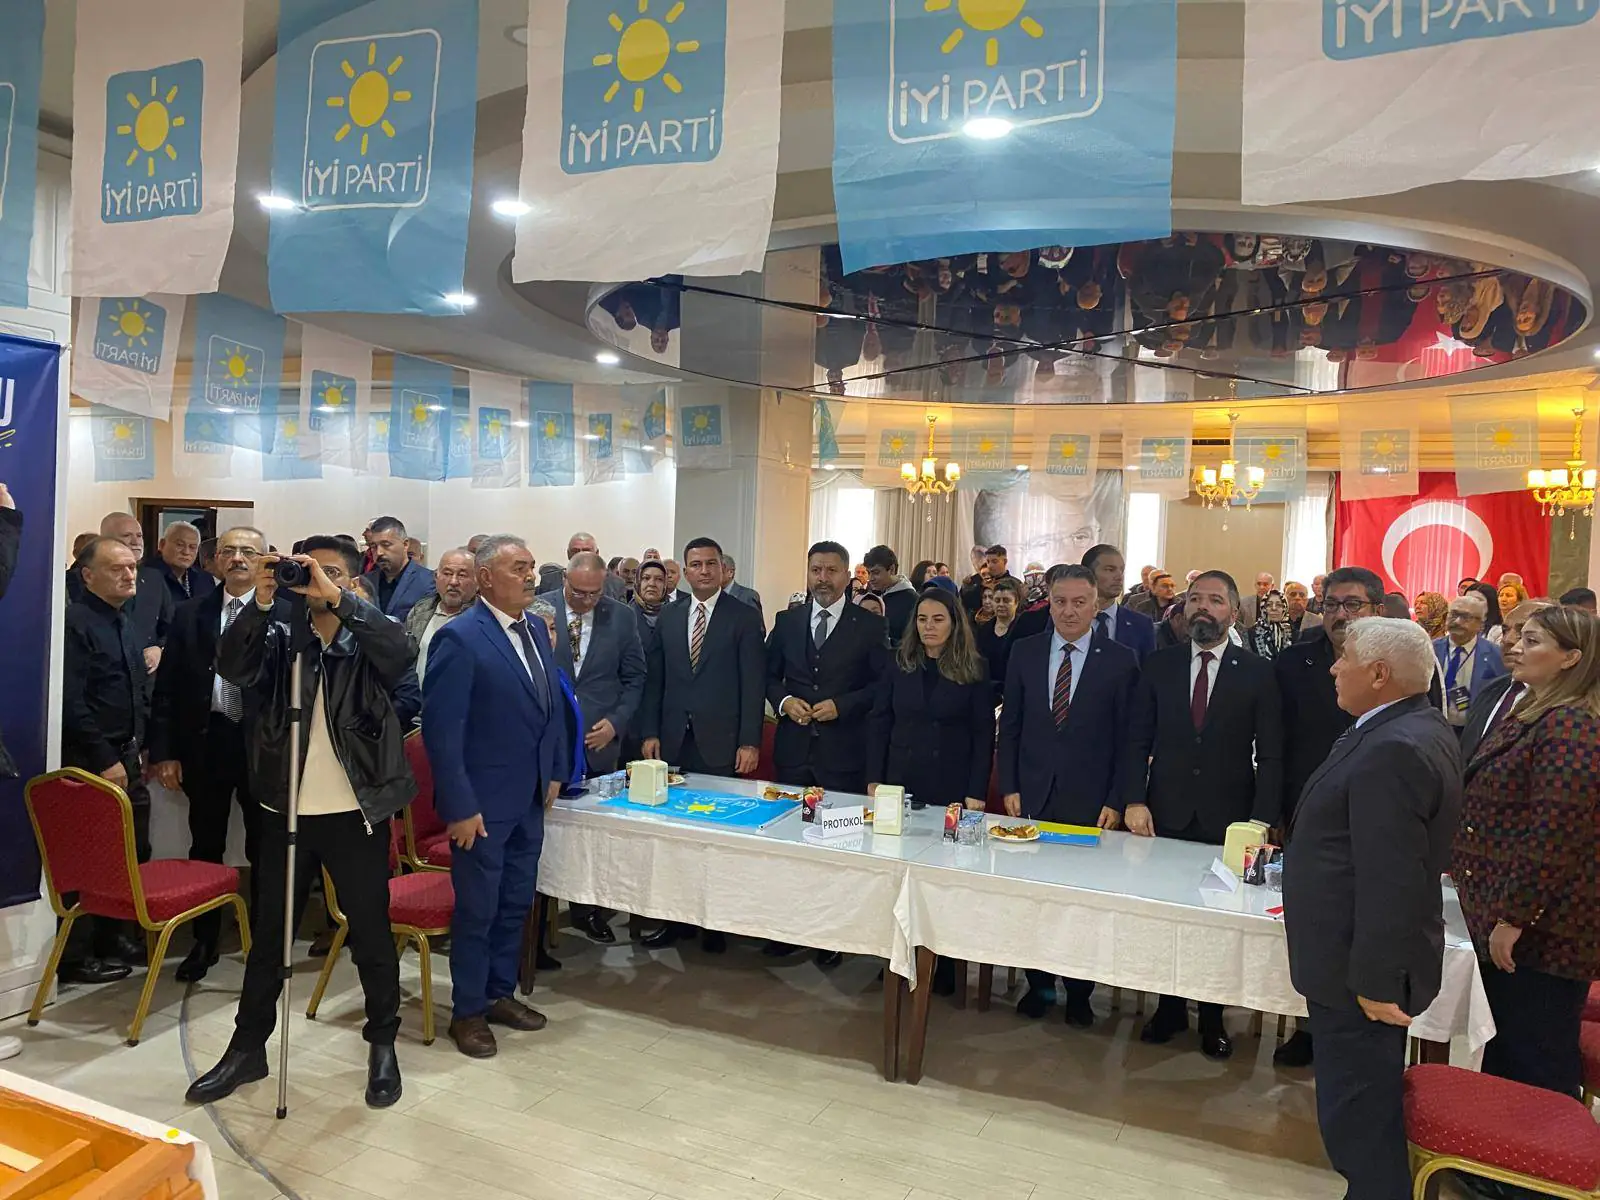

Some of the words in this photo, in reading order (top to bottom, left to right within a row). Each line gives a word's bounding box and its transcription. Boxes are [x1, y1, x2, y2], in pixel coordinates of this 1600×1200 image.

[899, 74, 951, 127] İYİ
[963, 49, 1088, 122] PARTİ
[567, 119, 609, 165] İYİ
[615, 108, 716, 159] PARTİ
[105, 180, 132, 216] İYİ
[136, 172, 197, 213] PARTİ
[307, 158, 340, 197] İYİ
[344, 154, 422, 195] PARTİ
[823, 816, 864, 830] PROTOKOL
